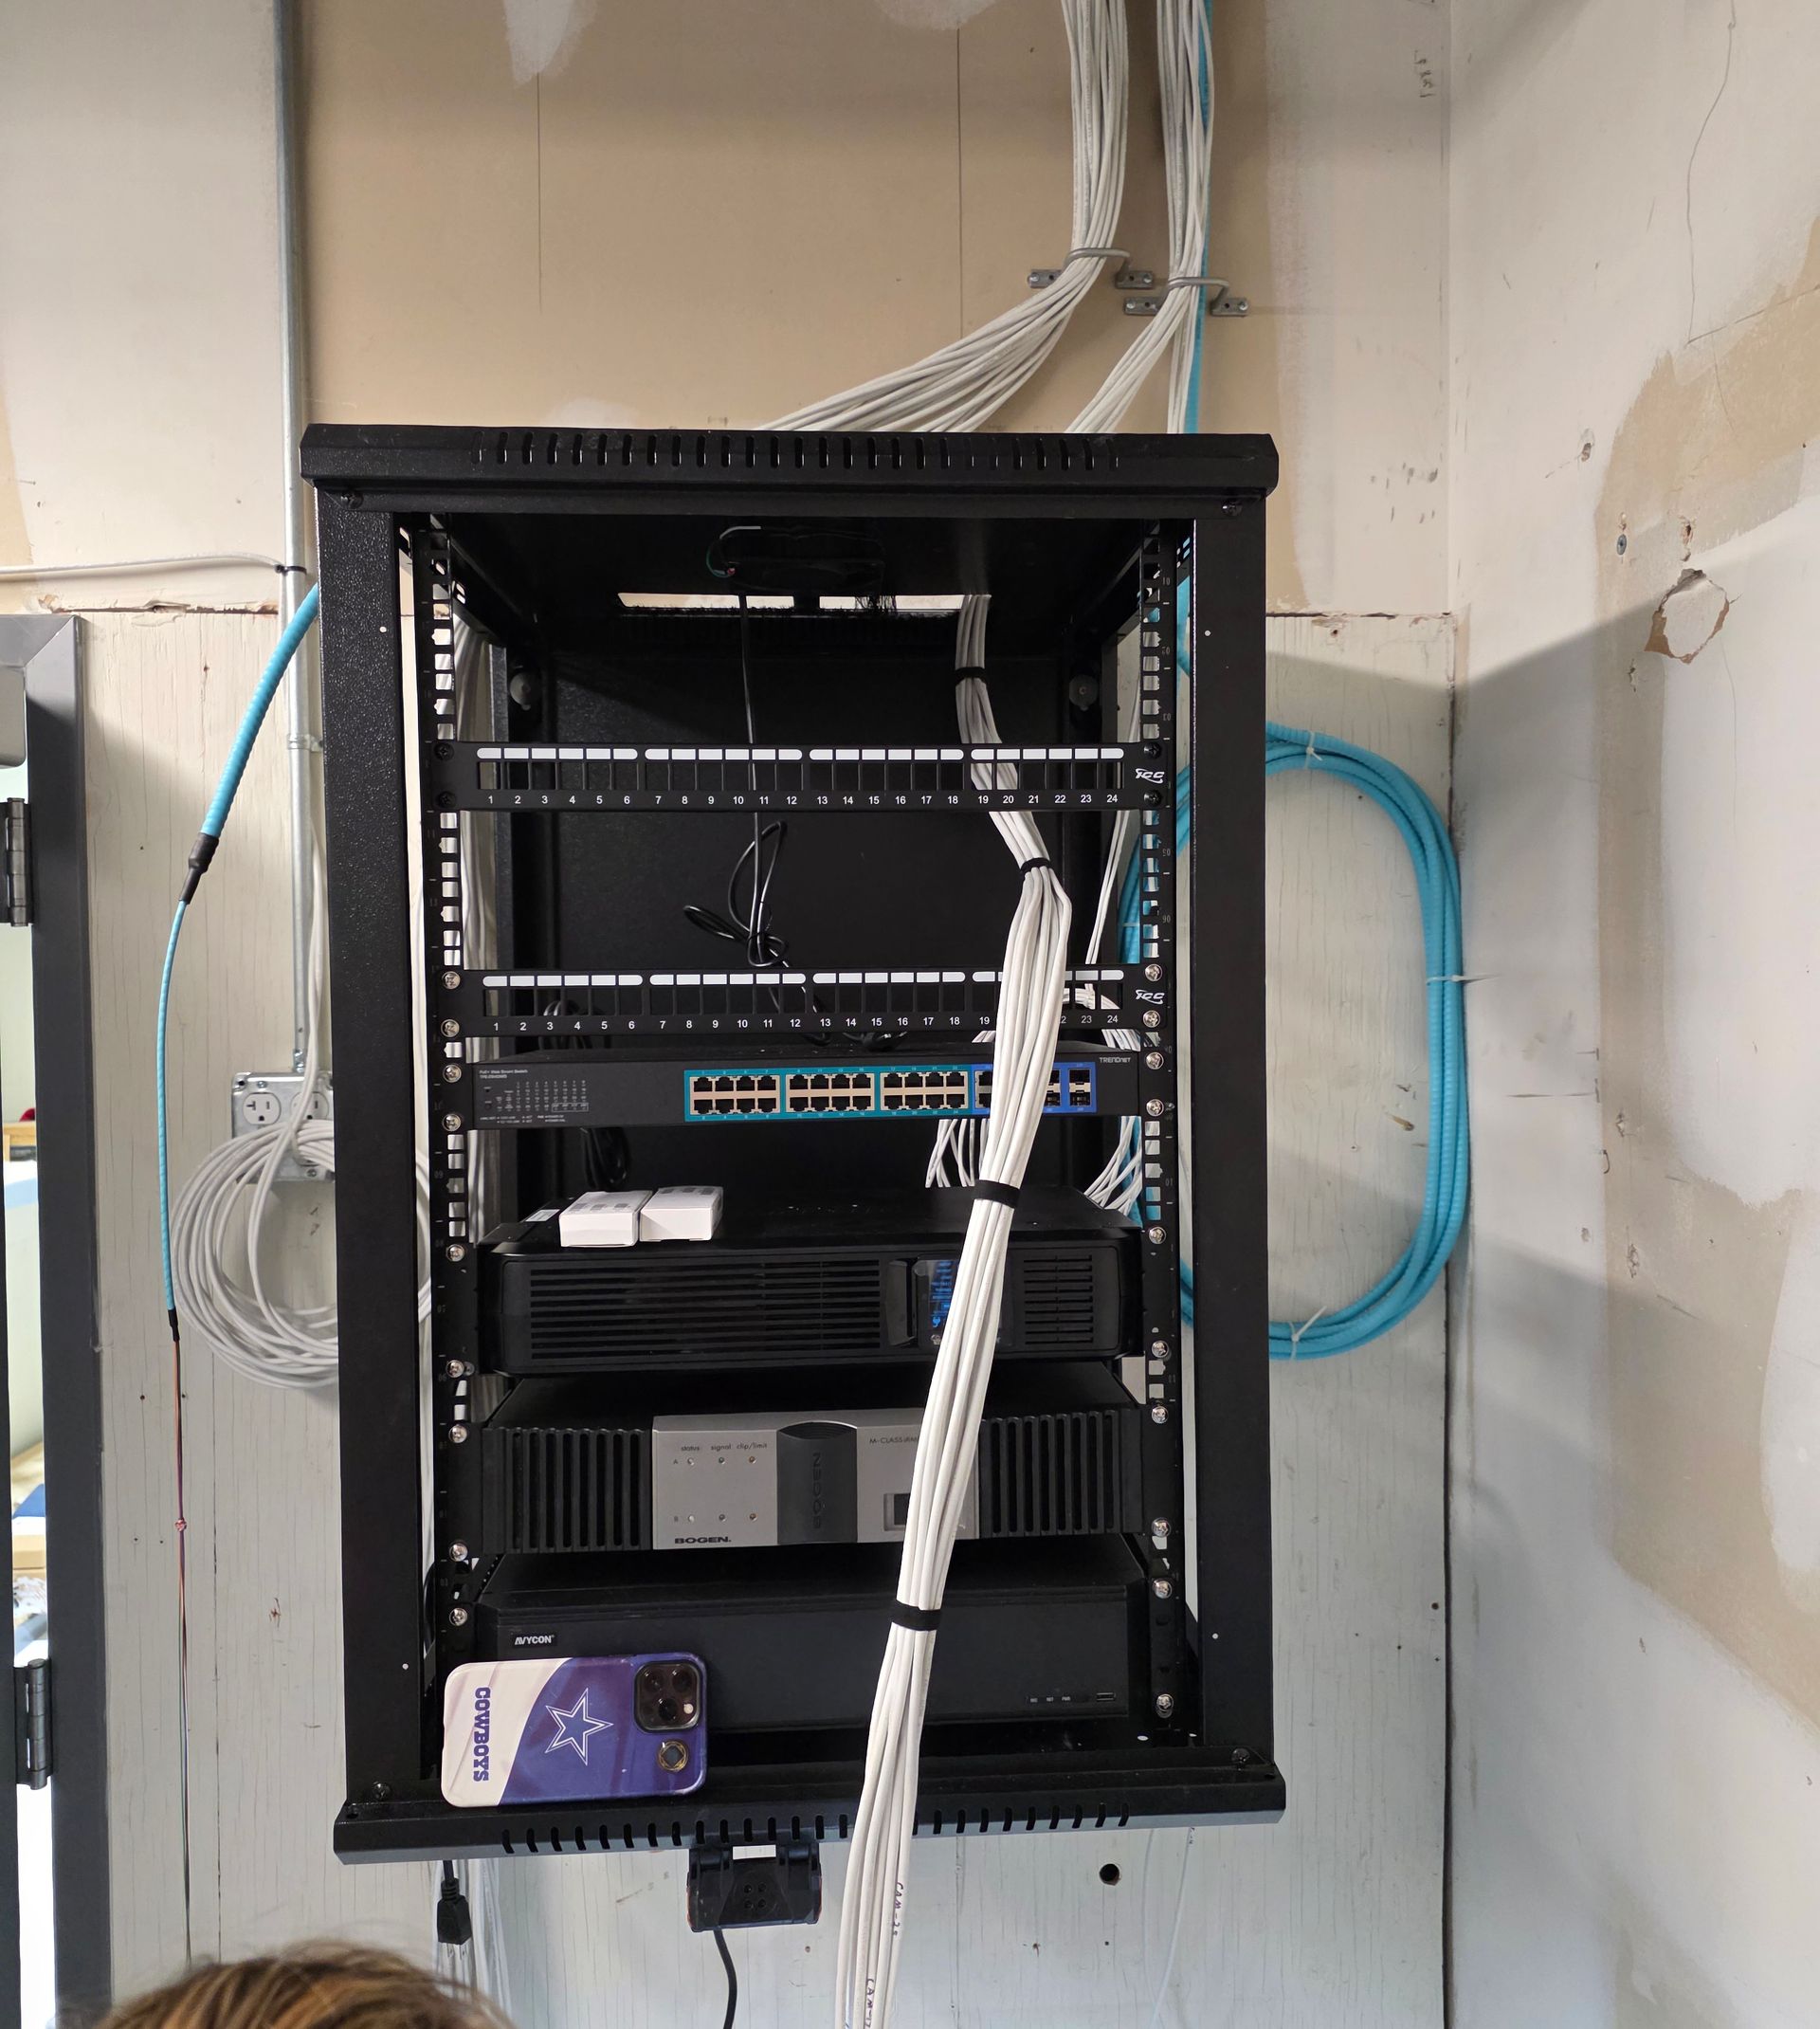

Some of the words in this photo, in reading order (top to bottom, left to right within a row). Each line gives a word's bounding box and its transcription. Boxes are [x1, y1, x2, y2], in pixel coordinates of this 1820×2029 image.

[487, 795, 494, 805] 1
[514, 795, 521, 805] 2
[541, 795, 549, 805] 3
[569, 795, 576, 805] 4
[595, 795, 604, 805] 5
[623, 795, 630, 805] 6
[655, 795, 662, 805] 7
[682, 795, 688, 805] 8
[707, 795, 715, 805] 9
[733, 795, 744, 805] 10
[758, 795, 769, 805] 11
[786, 795, 798, 805] 12
[816, 795, 828, 805] 13
[842, 795, 854, 805] 14
[868, 795, 880, 805] 15
[895, 795, 906, 805] 16
[920, 795, 933, 805] 17
[947, 795, 959, 805] 18
[977, 795, 990, 804] 19
[1002, 795, 1014, 804] 20
[1028, 795, 1039, 804] 21
[1054, 794, 1066, 804] 22
[1080, 794, 1092, 804] 23
[1106, 794, 1119, 803] 24
[493, 1022, 499, 1032] 1
[519, 1021, 527, 1032] 2
[546, 1021, 554, 1031] 3
[573, 1021, 581, 1031] 4
[601, 1020, 609, 1030] 5
[628, 1020, 636, 1030] 6
[659, 1020, 666, 1030] 7
[685, 1019, 693, 1029] 8
[712, 1019, 719, 1029] 9
[737, 1019, 749, 1029] 10
[763, 1018, 773, 1028] 11
[790, 1018, 801, 1028] 12
[820, 1017, 831, 1027] 13
[845, 1017, 857, 1027] 14
[871, 1017, 883, 1027] 15
[897, 1016, 909, 1026] 16
[922, 1016, 935, 1026] 17
[949, 1016, 960, 1026] 18
[979, 1015, 991, 1026] 19
[1081, 1014, 1092, 1024] 23
[1106, 1014, 1119, 1024] 24
[710, 1443, 732, 1453] signal
[736, 1442, 768, 1451] clip/limit
[514, 1635, 552, 1646] AVYCON
[473, 1687, 491, 1782] COWBOYS
